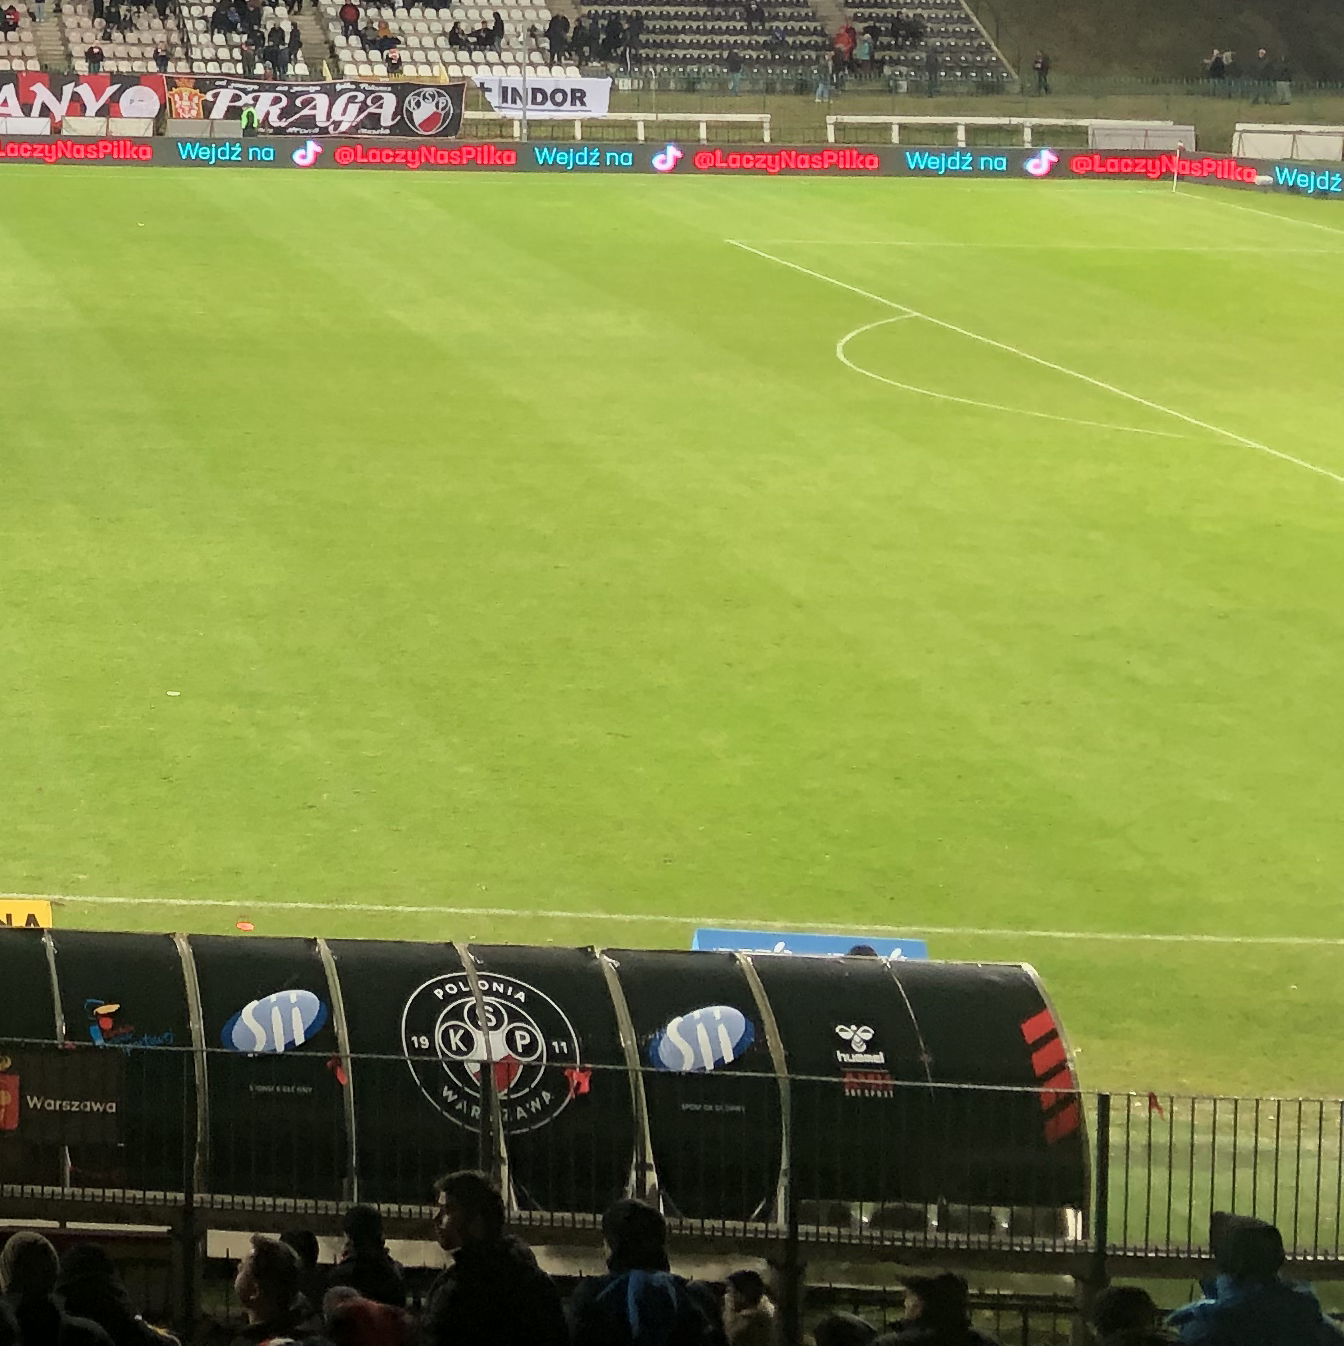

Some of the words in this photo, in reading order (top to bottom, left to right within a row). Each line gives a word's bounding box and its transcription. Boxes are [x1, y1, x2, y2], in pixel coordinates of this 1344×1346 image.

[206, 87, 401, 135] PRAGA
[177, 141, 242, 164] Wejdź
[249, 147, 274, 161] na
[534, 146, 600, 170] Wejdź
[606, 151, 633, 165] na
[905, 151, 973, 175] Wejdź
[979, 156, 1007, 170] na
[1275, 167, 1343, 194] Wejdź
[434, 980, 526, 1003] POLONIA
[411, 1036, 430, 1049] 19
[552, 1041, 568, 1054] 11
[26, 1095, 117, 1113] Warszawa
